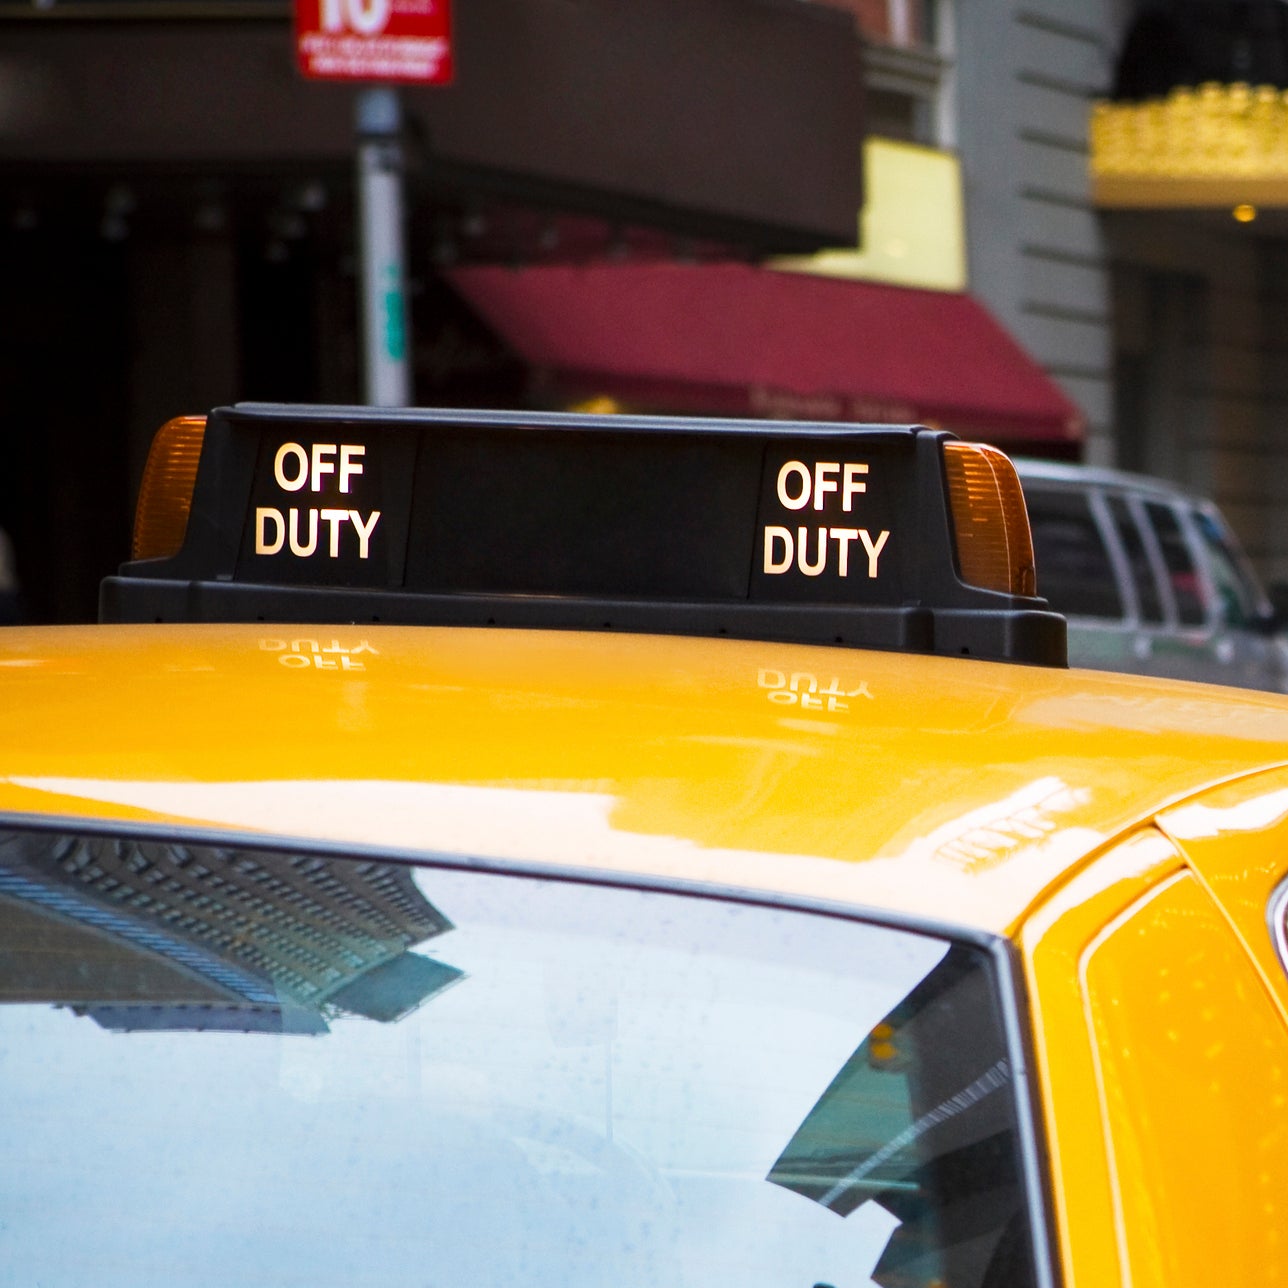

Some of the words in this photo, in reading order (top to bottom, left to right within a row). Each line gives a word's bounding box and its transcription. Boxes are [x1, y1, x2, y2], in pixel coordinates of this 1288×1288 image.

[274, 442, 366, 494] OFF
[776, 460, 869, 512] OFF
[255, 507, 381, 559] DUTY
[763, 526, 890, 578] DUTY
